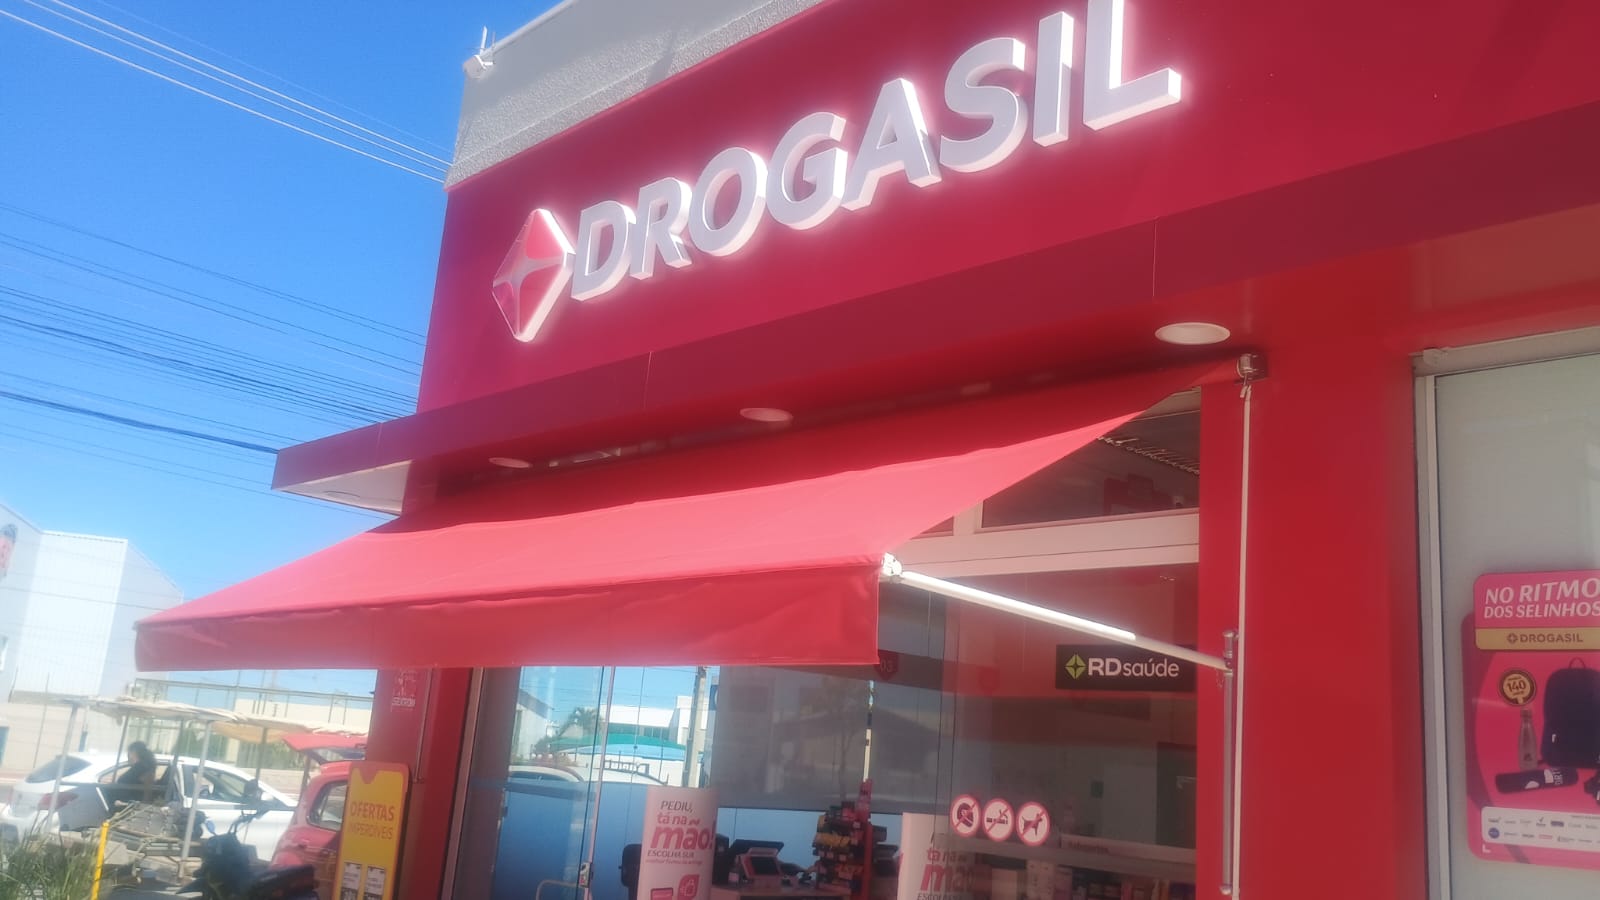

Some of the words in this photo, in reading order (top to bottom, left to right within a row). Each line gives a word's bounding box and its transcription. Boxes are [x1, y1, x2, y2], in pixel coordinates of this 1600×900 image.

[571, 0, 1182, 301] DROGASIL
[1485, 586, 1514, 604] NO
[1519, 577, 1600, 603] RITMO
[1484, 606, 1513, 618] DOS
[1516, 602, 1600, 618] SELINHOS
[1519, 633, 1584, 643] DROGASIL
[1506, 679, 1527, 693] 140
[350, 802, 396, 822] OFERTAS
[660, 800, 694, 813] PEDIU,
[672, 815, 688, 825] na
